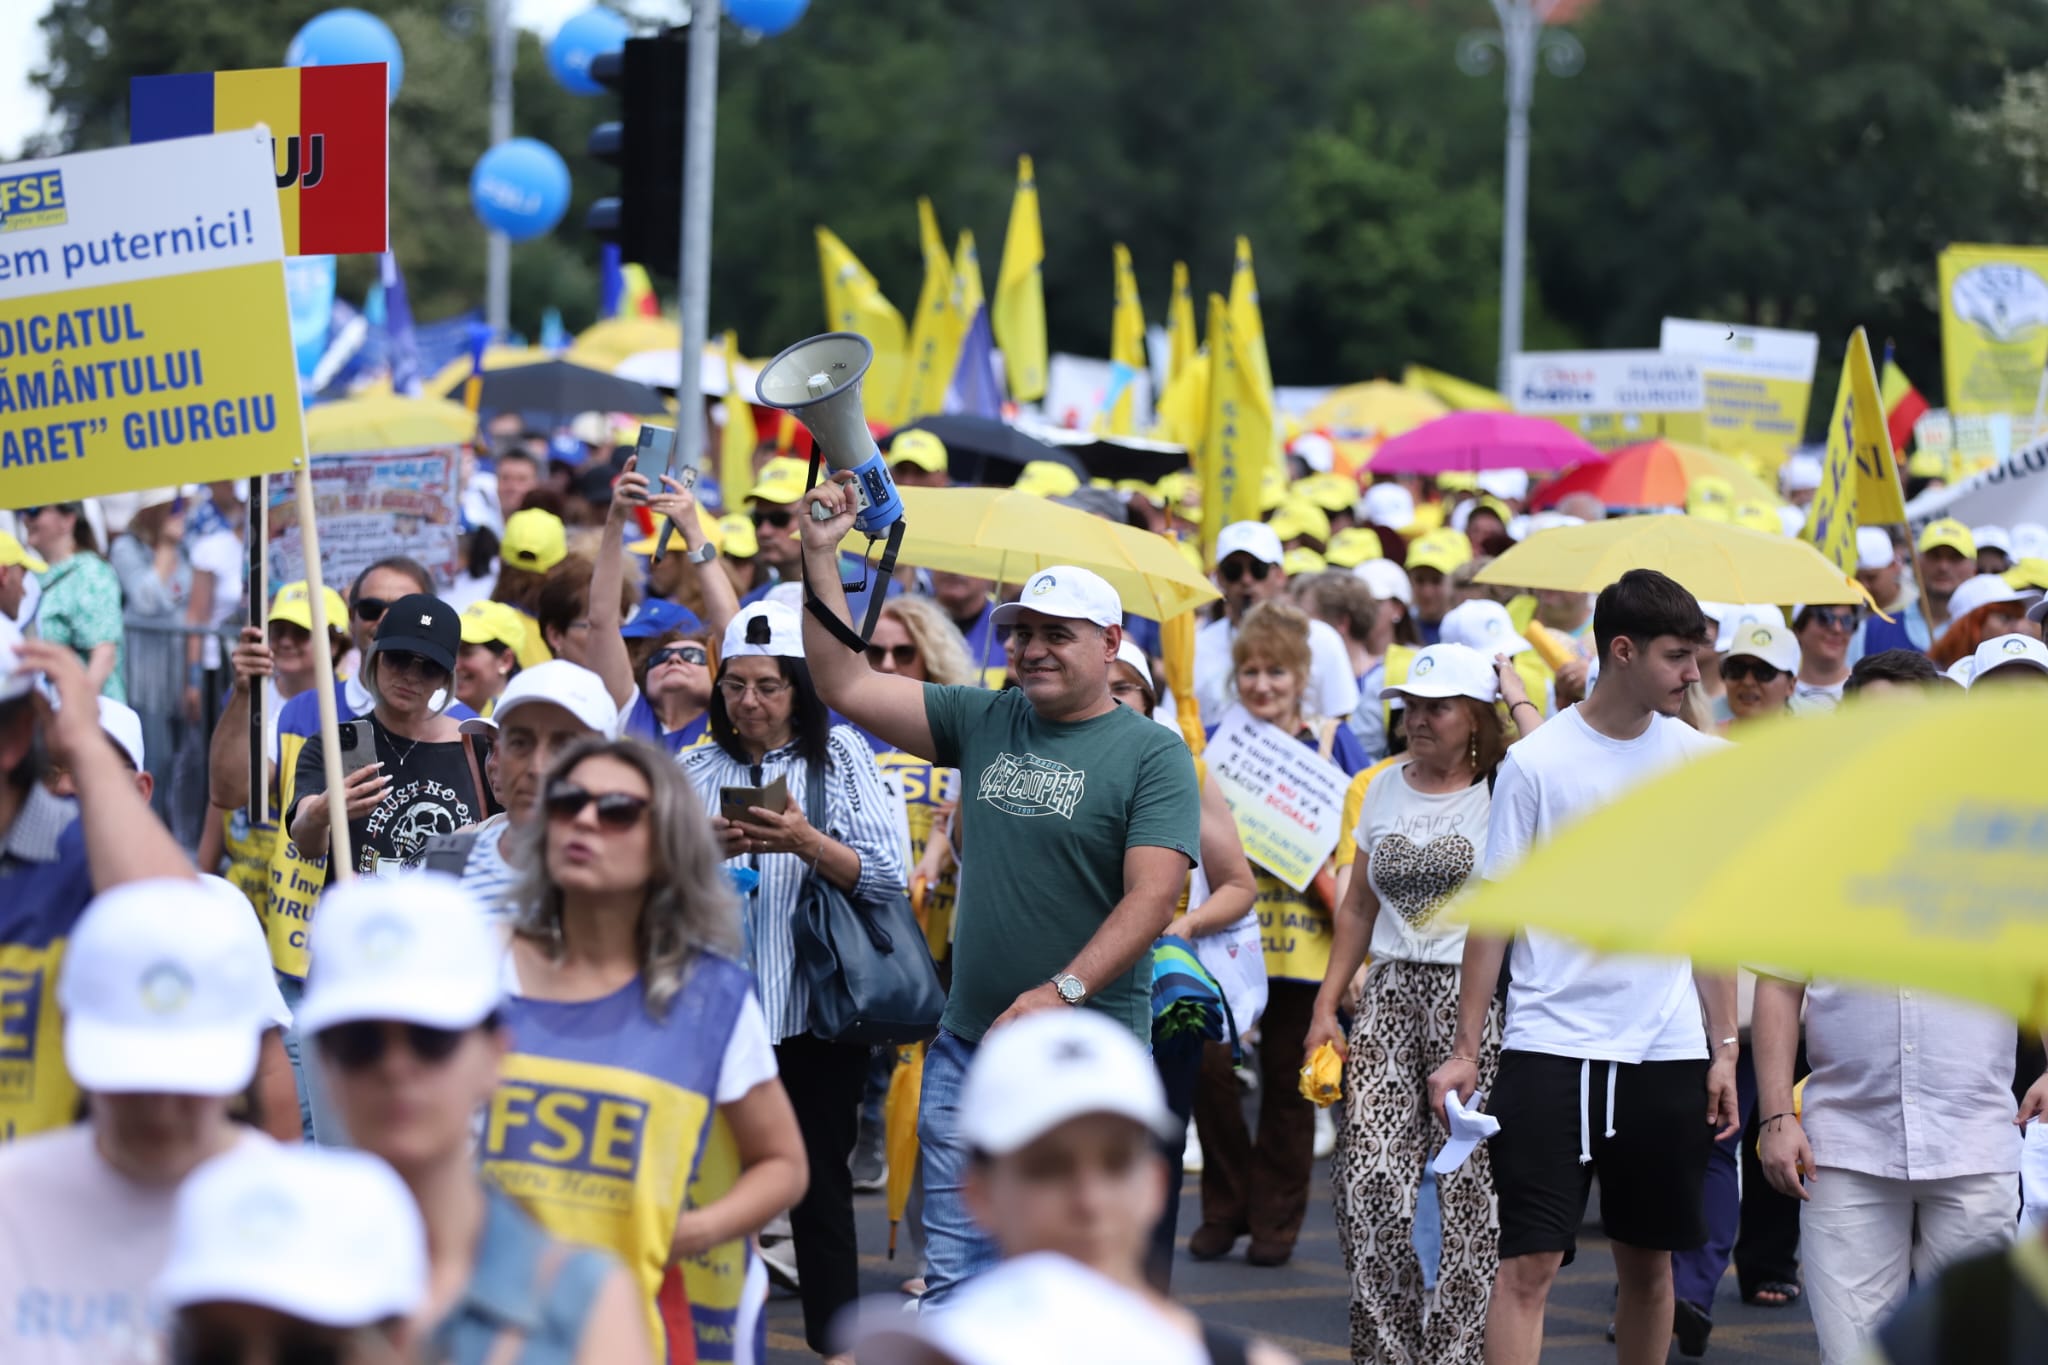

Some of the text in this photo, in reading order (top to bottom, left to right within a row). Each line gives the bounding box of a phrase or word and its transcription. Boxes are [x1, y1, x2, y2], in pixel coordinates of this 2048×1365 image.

[1, 174, 63, 211] FSE
[62, 209, 254, 279] puternici!
[123, 394, 277, 451] GIURGIU
[366, 780, 420, 833] TRUST
[424, 780, 456, 801] NO
[1007, 770, 1085, 820] COOPER
[487, 1087, 643, 1172] FSE
